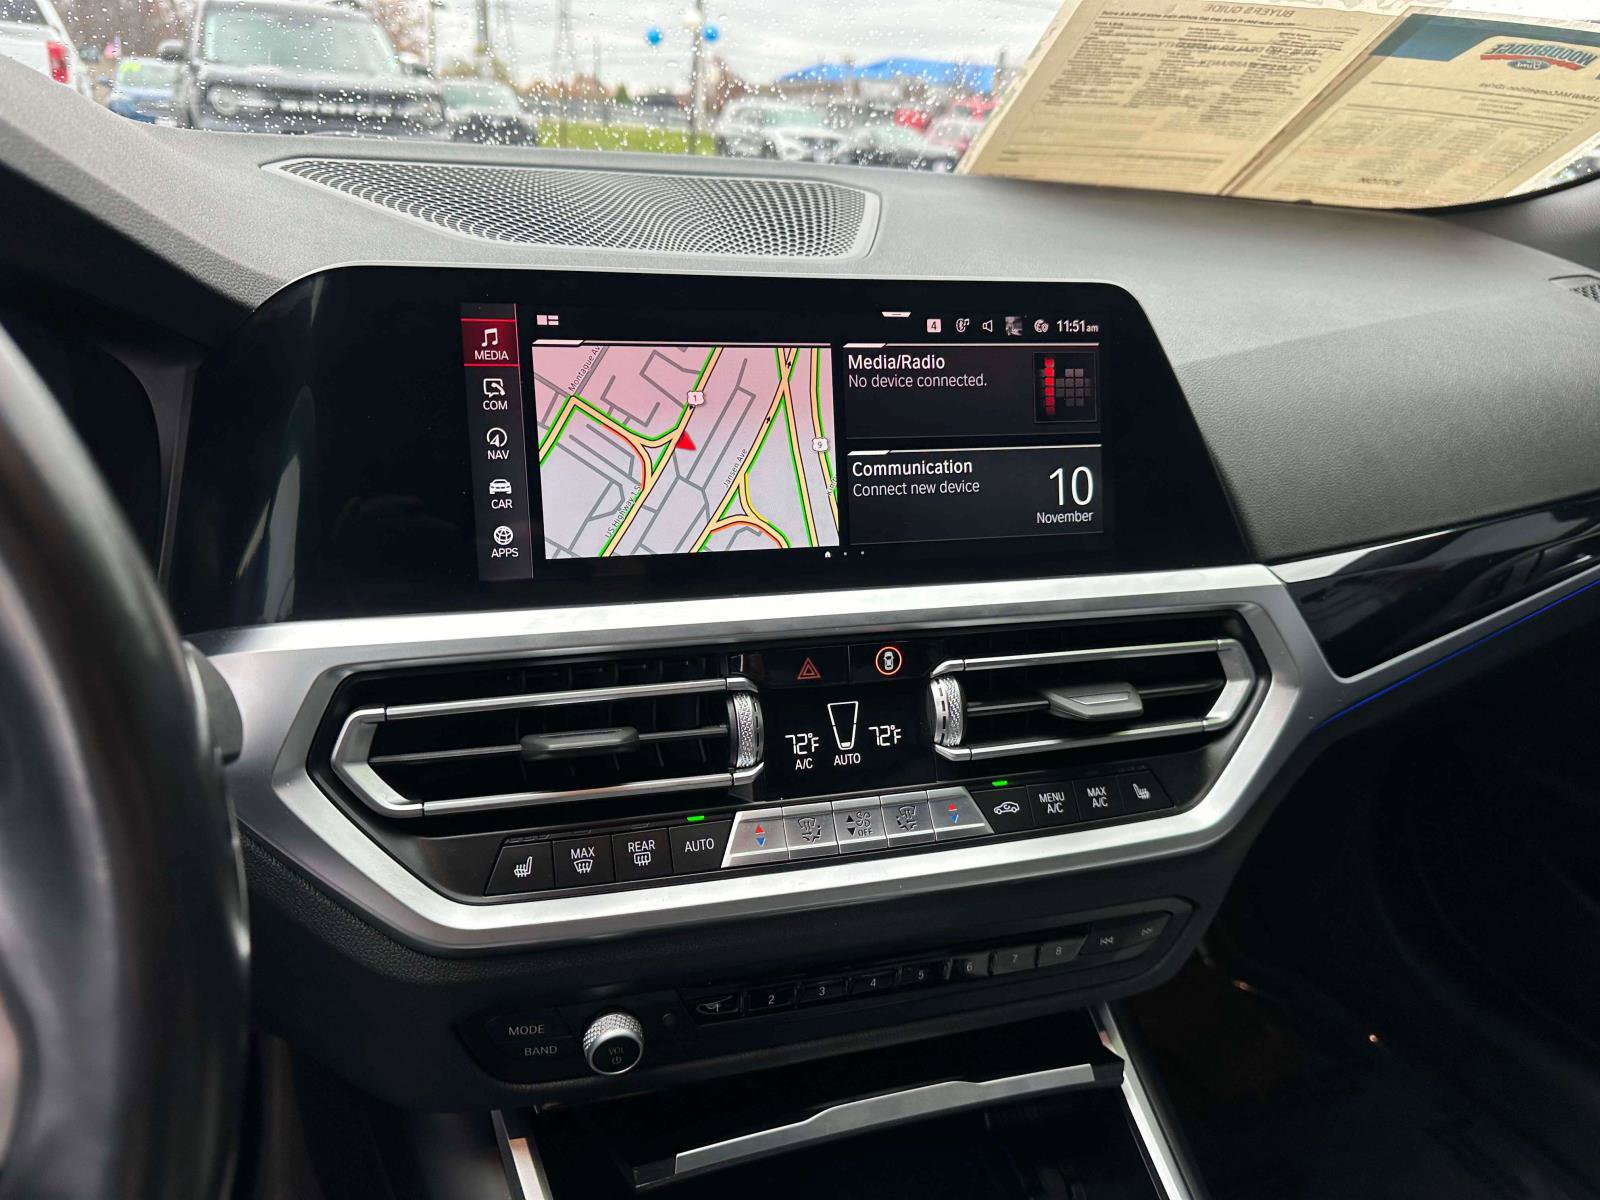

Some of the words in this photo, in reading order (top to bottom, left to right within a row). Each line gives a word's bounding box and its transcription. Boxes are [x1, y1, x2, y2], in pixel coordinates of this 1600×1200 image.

[1057, 319, 1099, 333] 11:51am
[474, 350, 509, 361] MEDIA
[848, 354, 946, 370] Media/Radio
[848, 374, 868, 388] No
[871, 374, 914, 388] device
[917, 374, 987, 388] connected.
[483, 400, 508, 411] COM
[487, 449, 509, 460] NAV
[723, 463, 740, 488] Jansen
[739, 448, 748, 464] Ave
[852, 460, 973, 476] Communication
[853, 483, 907, 497] Connect
[911, 483, 937, 495] new
[939, 480, 980, 495] device
[1050, 466, 1094, 506] 10
[491, 499, 513, 510] CAR
[611, 497, 633, 528] Highway
[1036, 511, 1093, 524] November
[491, 547, 519, 559] APPS
[794, 757, 814, 770] A/C
[833, 753, 861, 766] AUTO
[1038, 792, 1065, 803] MENU
[1087, 787, 1107, 799] MAX
[1047, 802, 1064, 815] A/C
[1092, 796, 1108, 809] A/C
[857, 827, 873, 837] OFF
[627, 840, 656, 853] REAR
[684, 838, 715, 853] AUTO
[570, 847, 596, 859] MAX
[966, 962, 973, 973] 6
[918, 970, 925, 981] 5
[818, 986, 826, 996] 3
[768, 994, 775, 1005] 2
[508, 1024, 545, 1036] MODE
[524, 1045, 558, 1057] BAND
